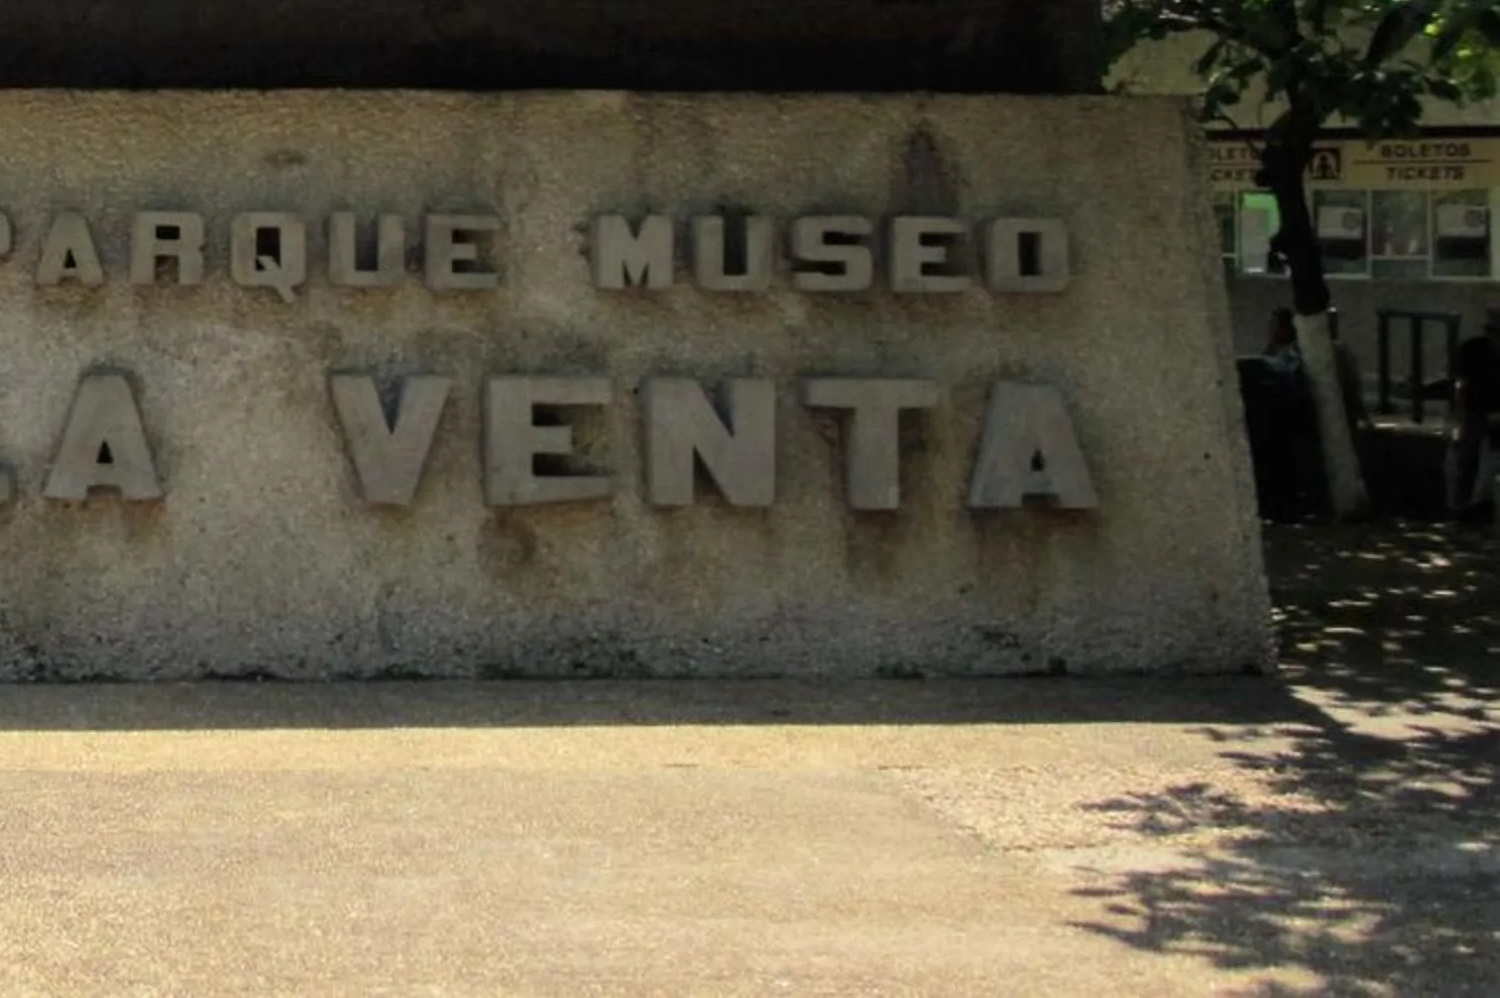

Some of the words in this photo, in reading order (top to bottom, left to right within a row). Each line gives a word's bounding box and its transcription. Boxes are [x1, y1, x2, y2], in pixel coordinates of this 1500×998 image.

[1381, 143, 1471, 157] BOLETOS
[1386, 166, 1465, 180] TICKETS
[587, 213, 1071, 293] MUSEO
[328, 371, 1100, 510] VENTA
